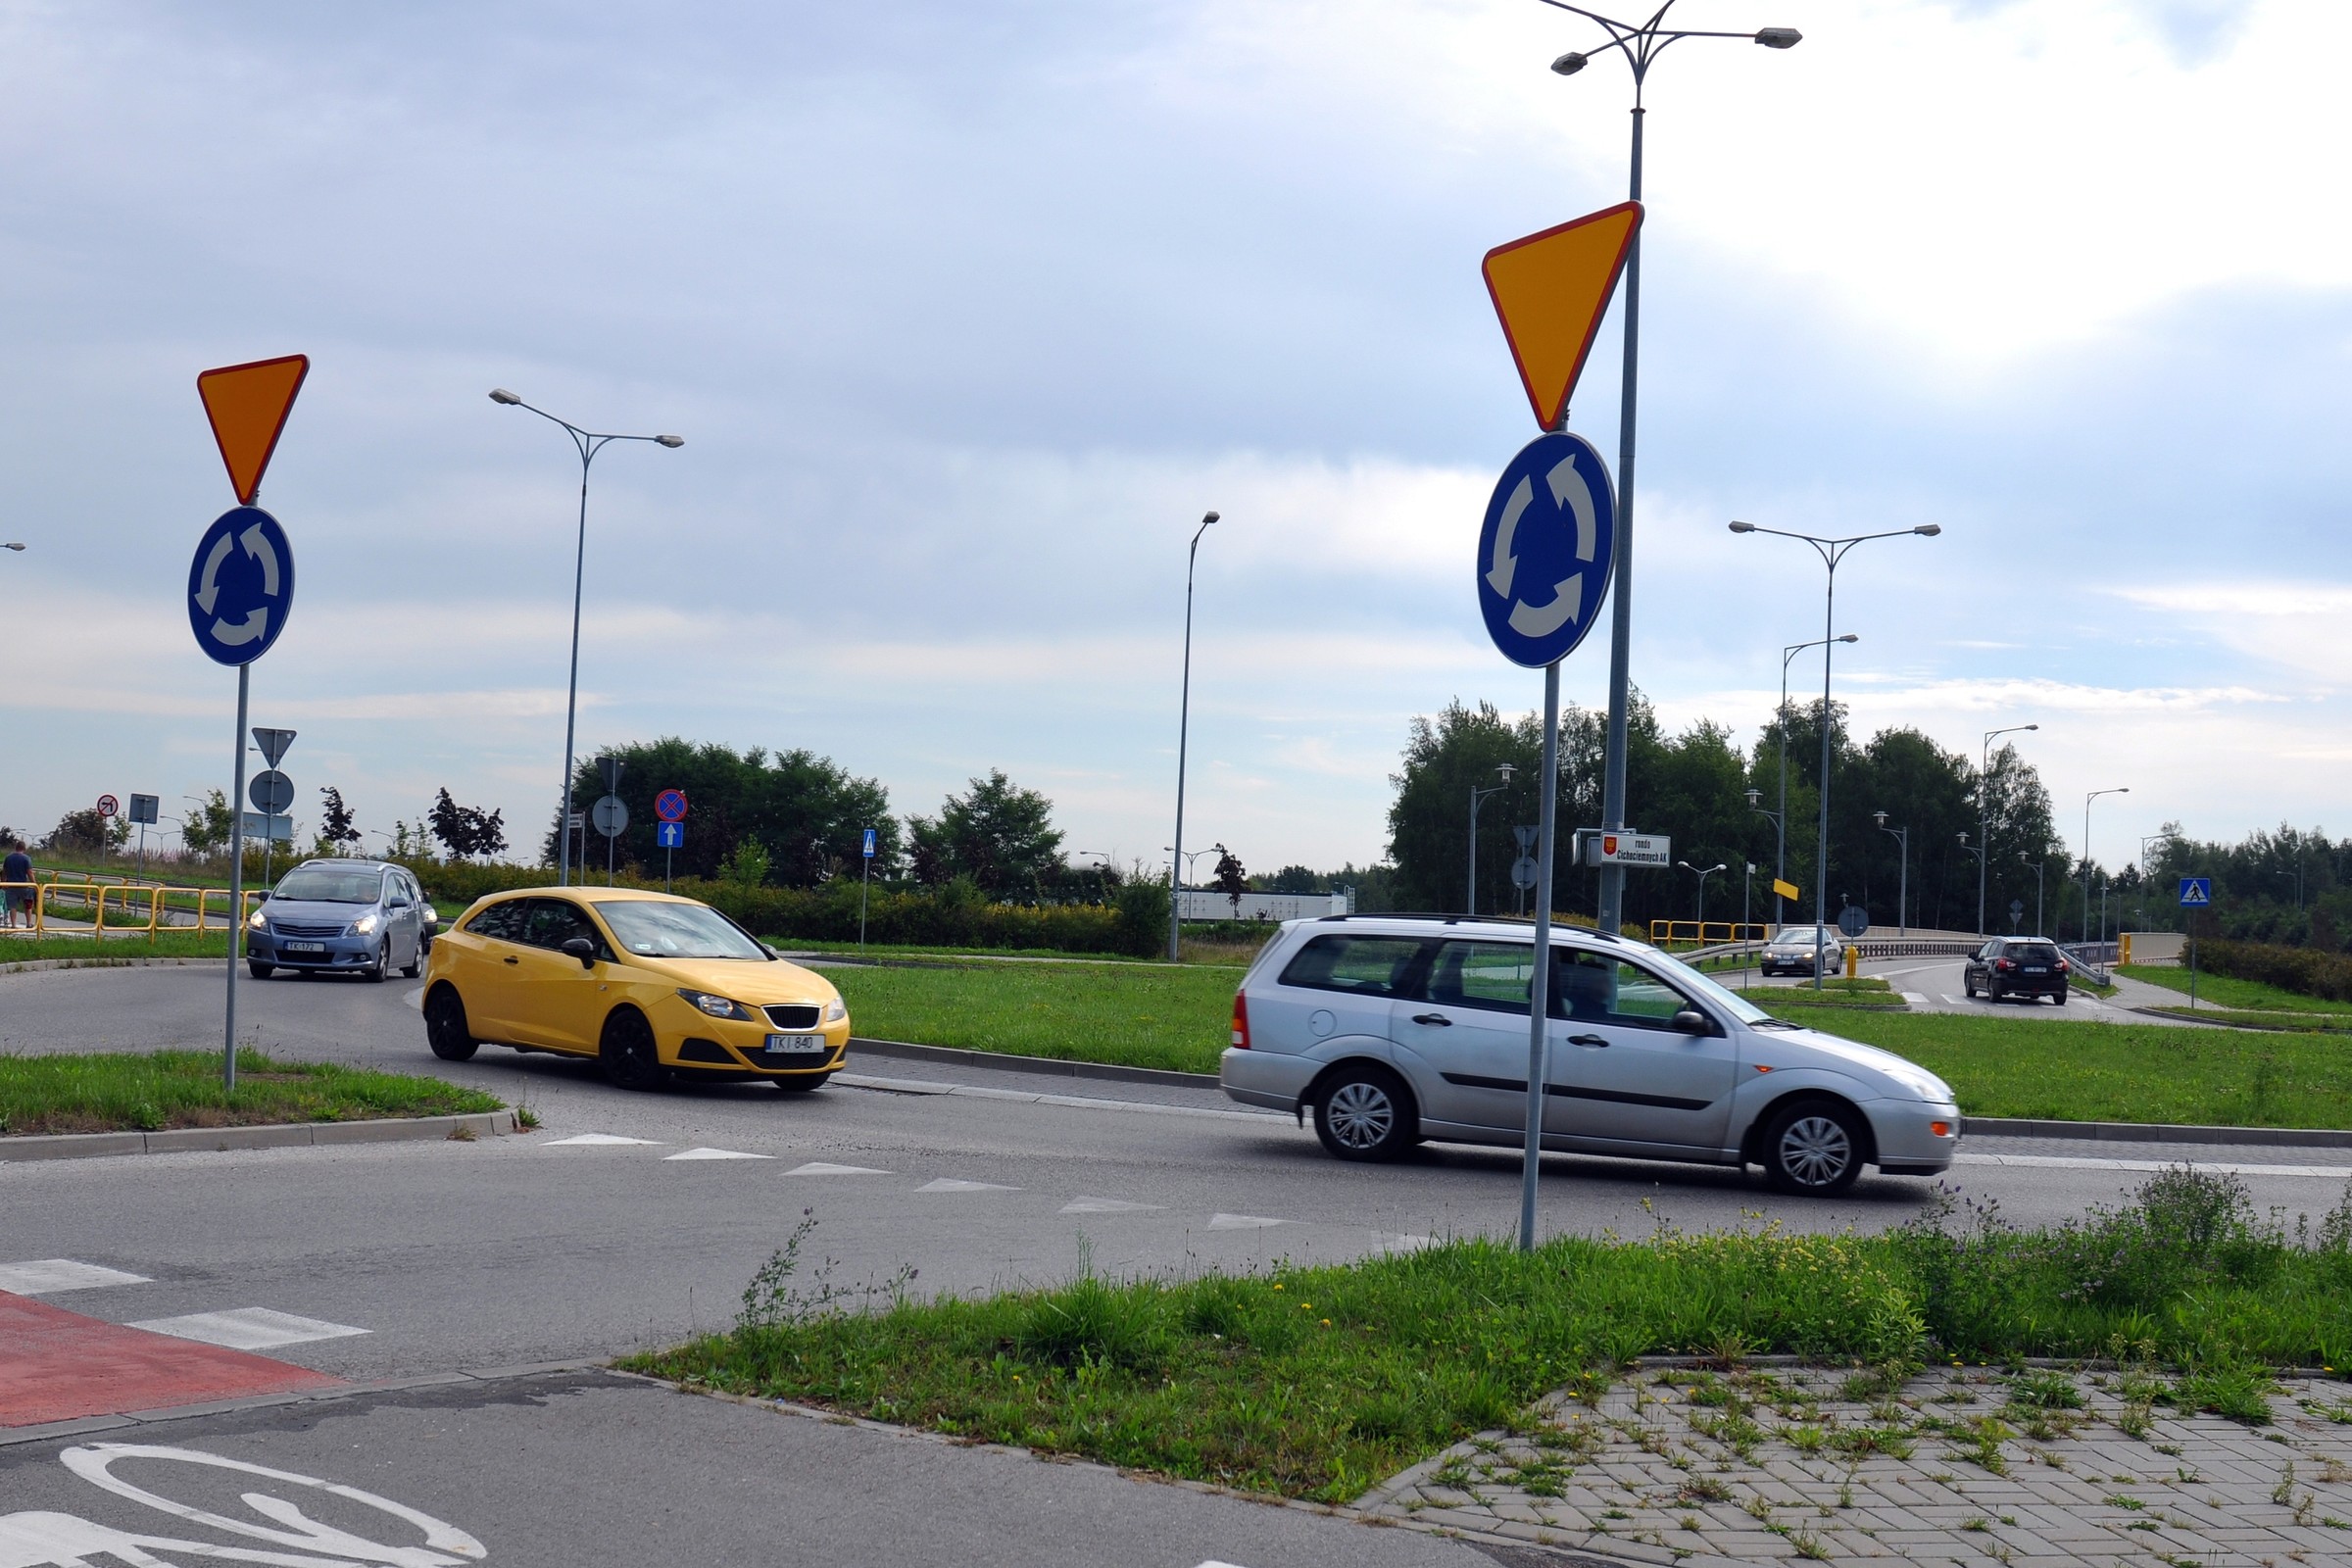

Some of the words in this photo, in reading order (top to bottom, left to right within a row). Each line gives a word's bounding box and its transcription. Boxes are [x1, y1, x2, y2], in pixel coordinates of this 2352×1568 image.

[1635, 839, 1650, 849] rondo
[1617, 850, 1658, 862] Cichociemnych
[1659, 853, 1667, 862] AK
[772, 1036, 791, 1049] TKI
[795, 1036, 813, 1049] 840
